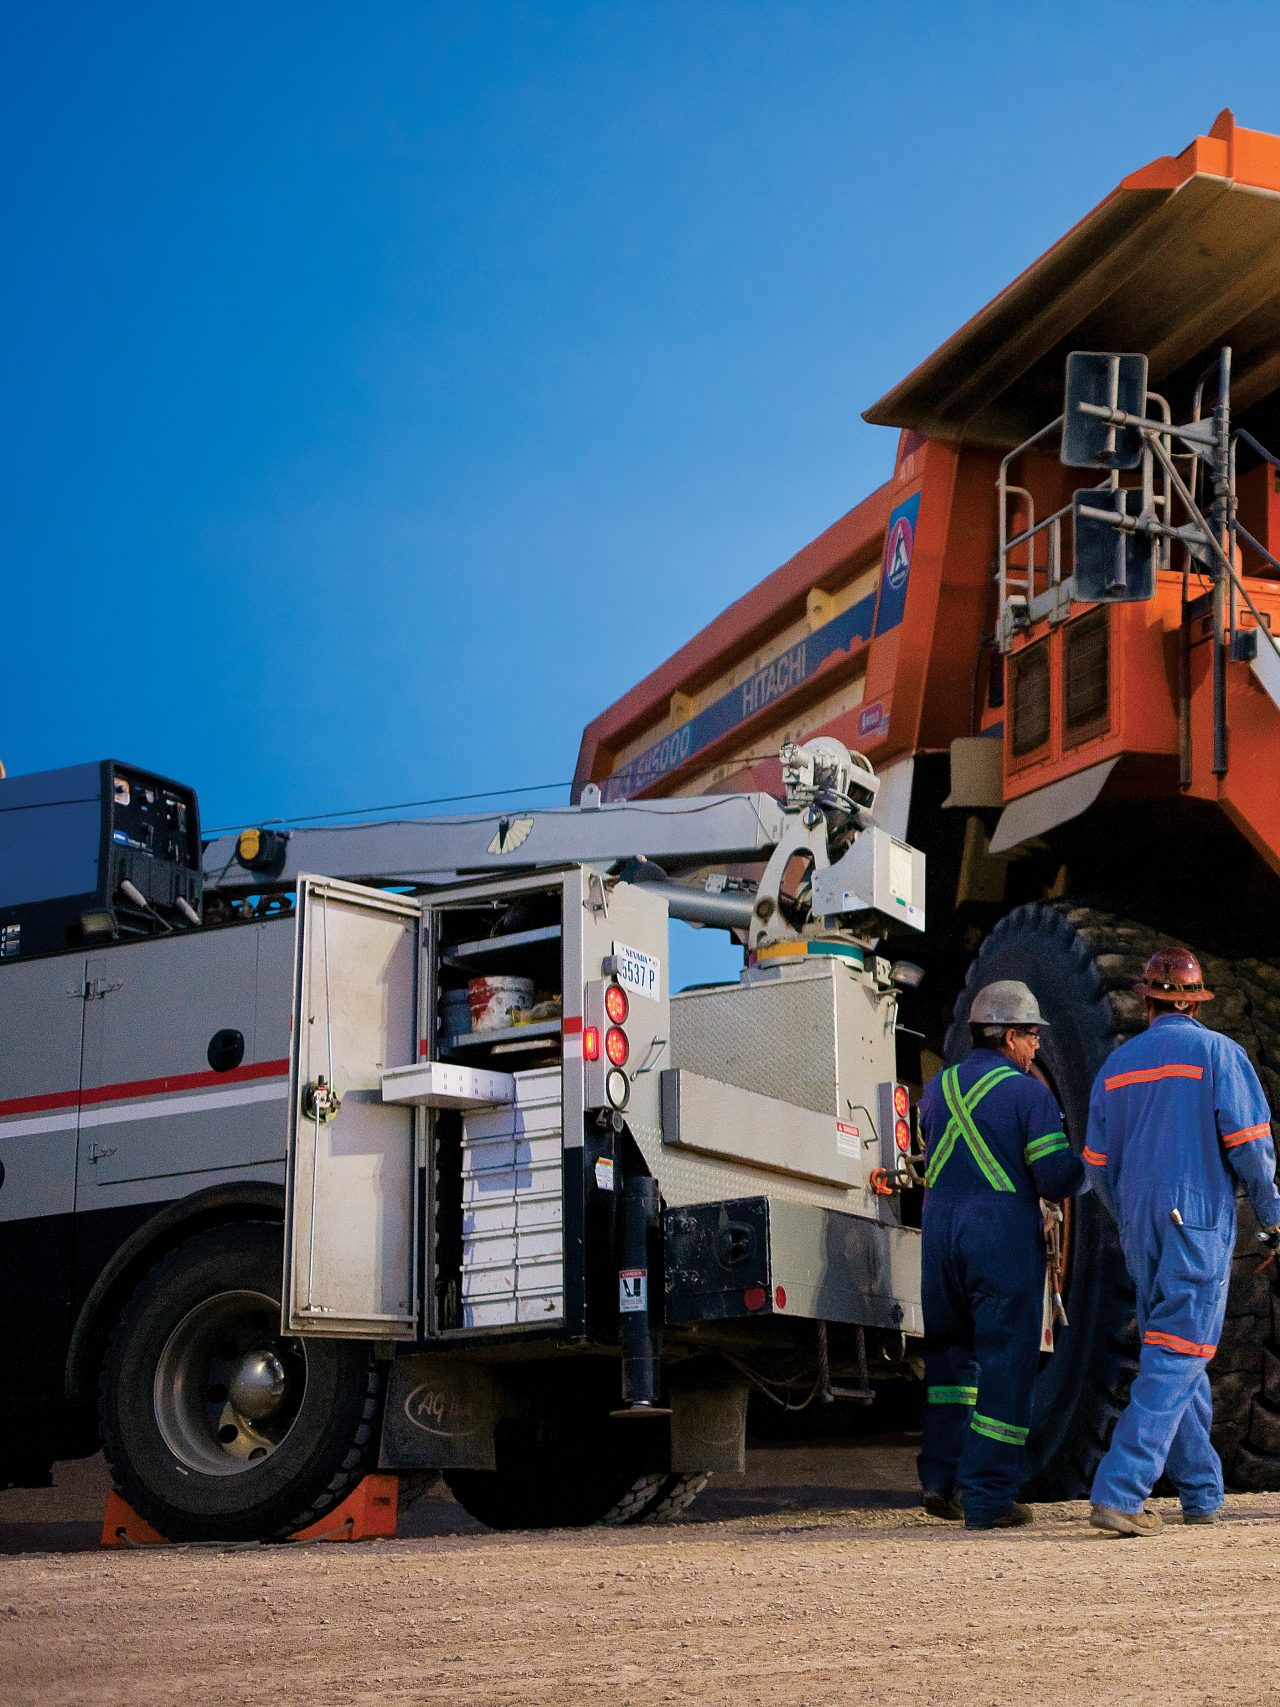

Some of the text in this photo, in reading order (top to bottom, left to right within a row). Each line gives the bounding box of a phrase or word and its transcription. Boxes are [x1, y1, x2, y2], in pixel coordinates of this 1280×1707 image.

[742, 642, 807, 717] HITACHI
[625, 948, 648, 964] NEVADA
[649, 969, 655, 990] P
